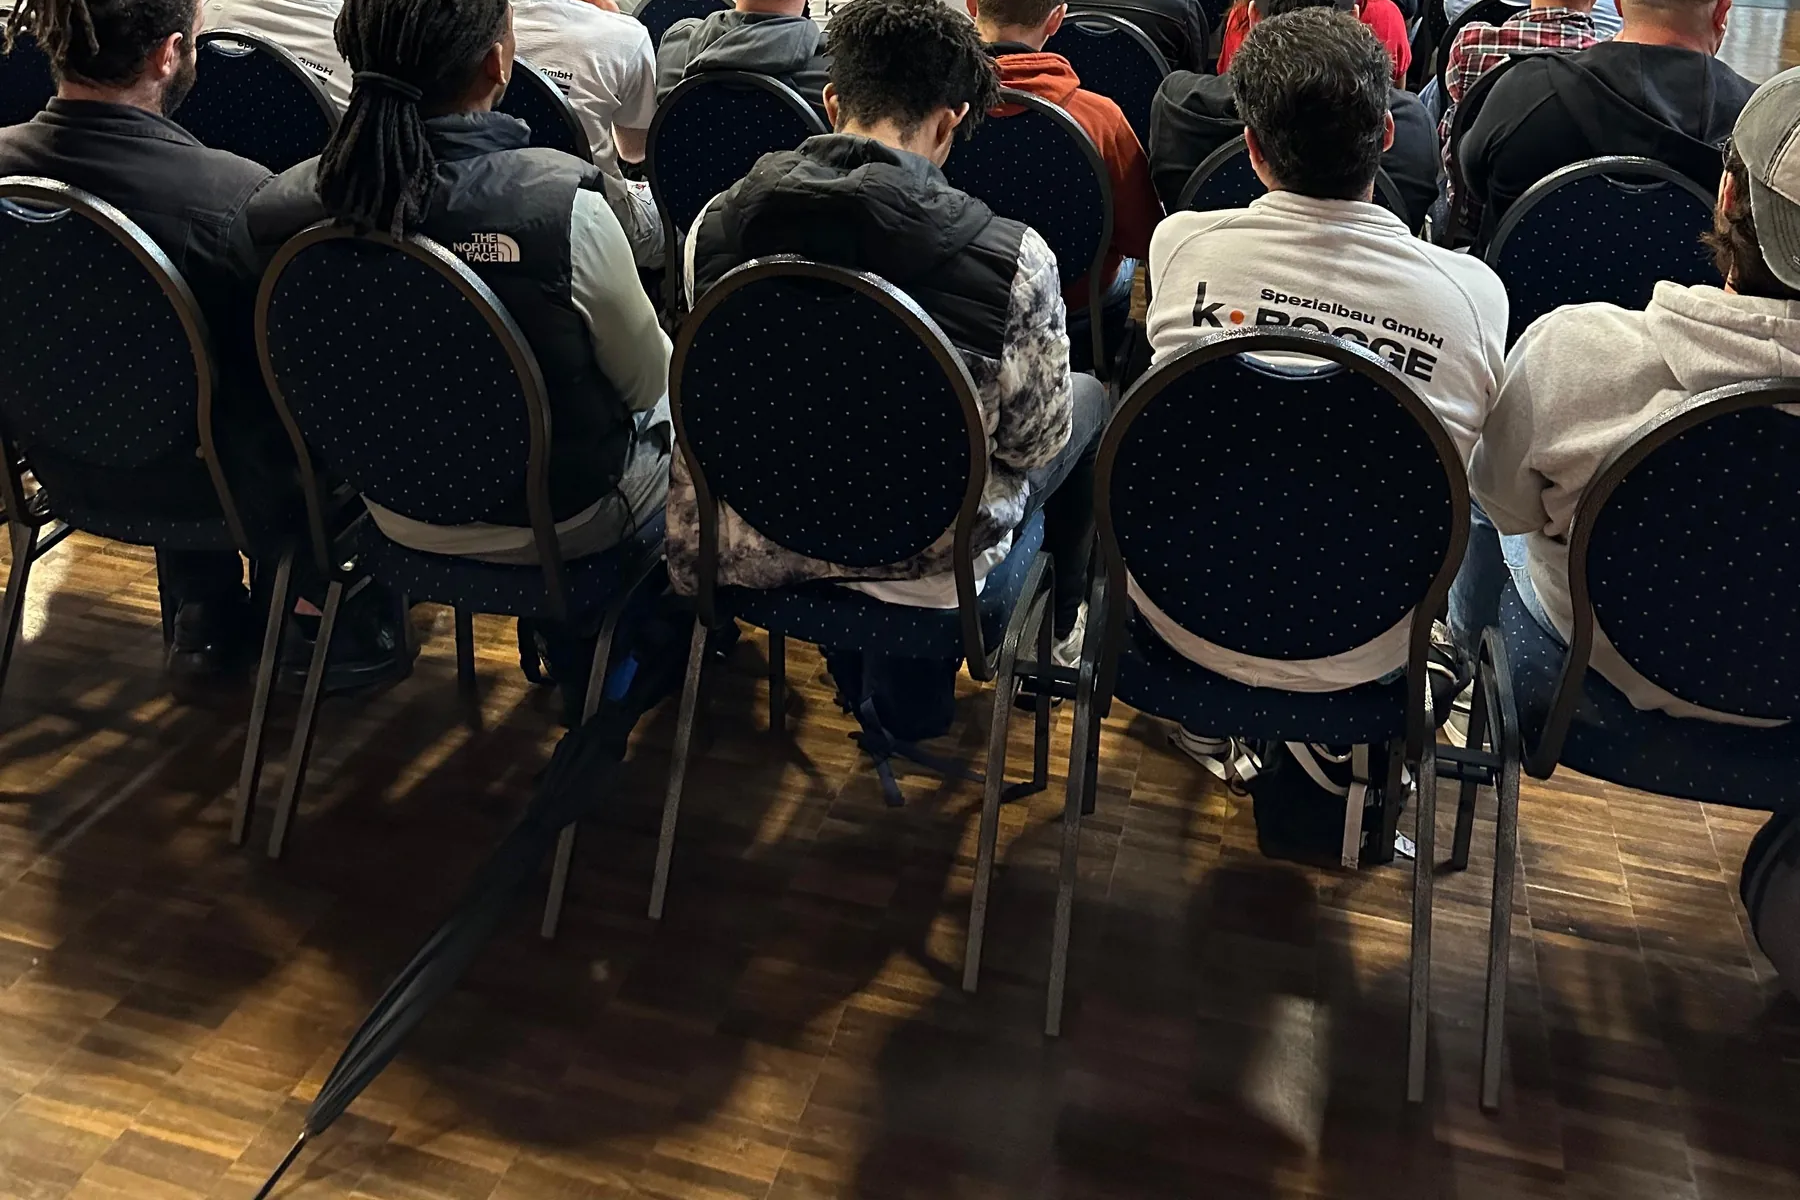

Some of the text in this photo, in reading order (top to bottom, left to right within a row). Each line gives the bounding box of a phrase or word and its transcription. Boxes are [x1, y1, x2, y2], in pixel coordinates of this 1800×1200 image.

[471, 233, 497, 243] THE
[453, 242, 498, 252] NORTH
[466, 252, 498, 262] FACE
[1191, 281, 1227, 329] k
[1259, 287, 1445, 350] Spezialbau GmbH
